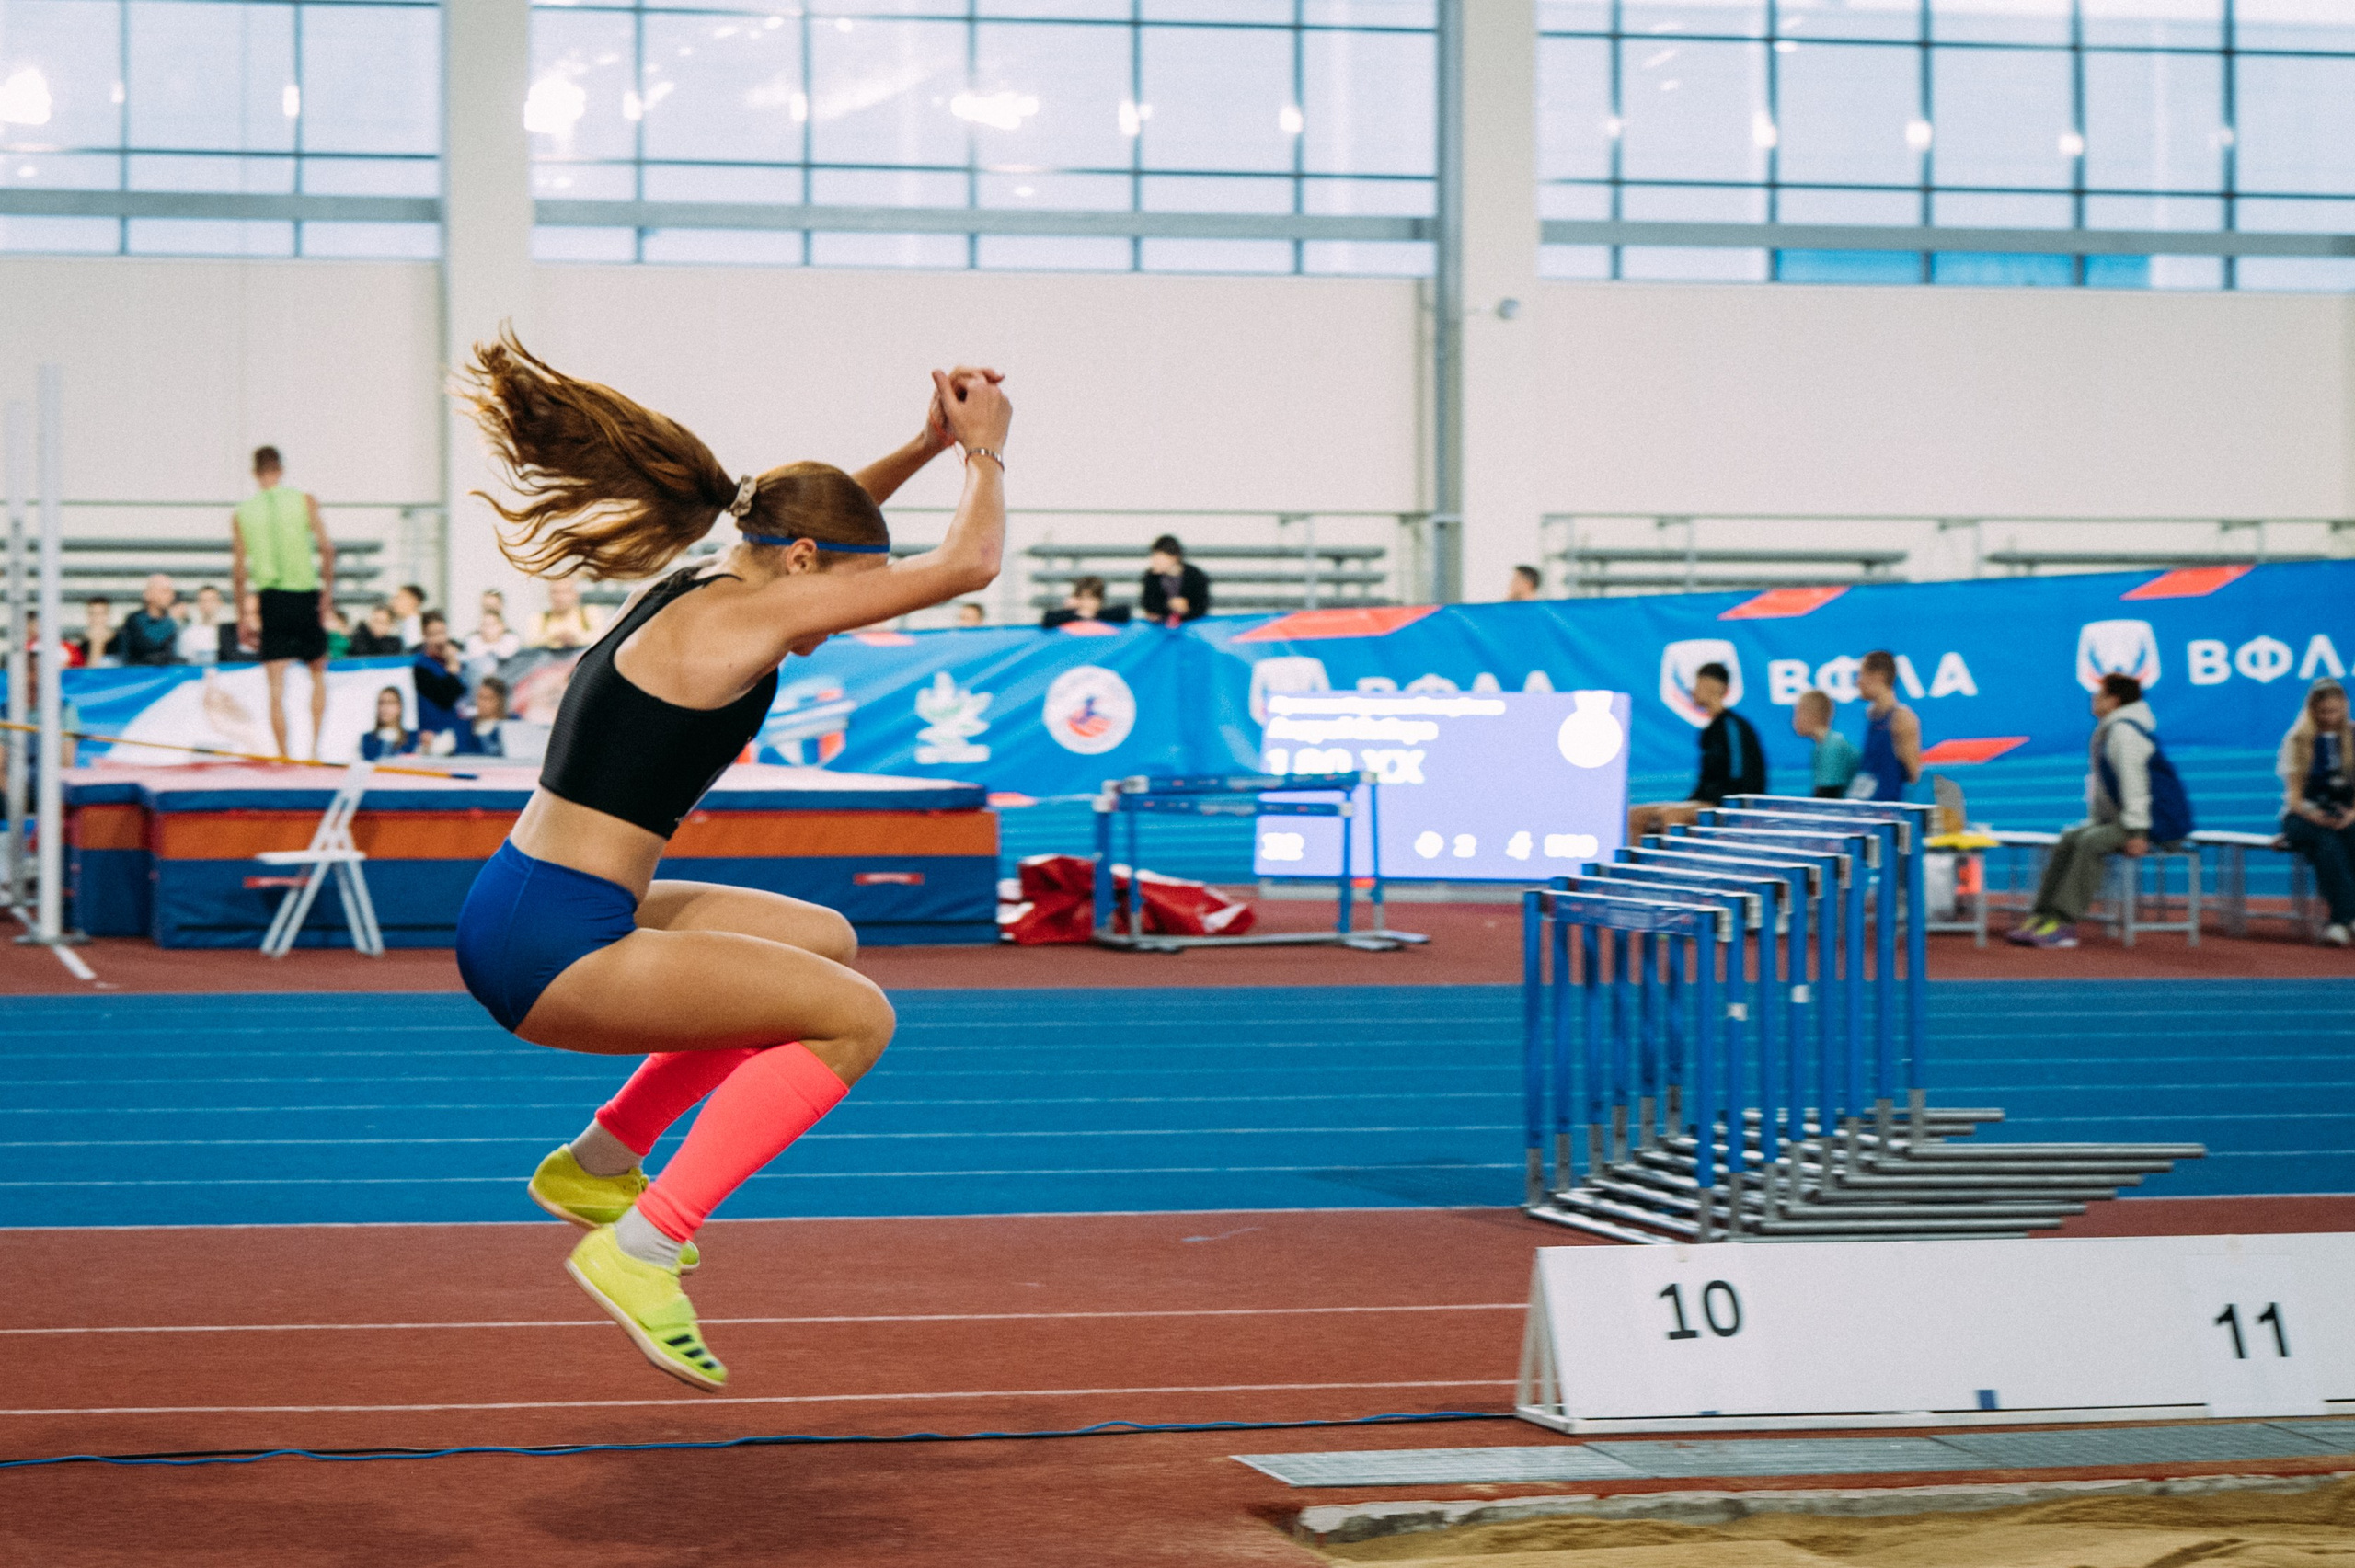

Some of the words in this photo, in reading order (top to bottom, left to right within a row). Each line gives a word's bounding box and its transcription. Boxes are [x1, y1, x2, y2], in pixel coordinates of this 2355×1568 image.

[2187, 634, 2355, 686] ВФЛ
[1657, 1279, 1743, 1341] 10
[2213, 1301, 2292, 1361] 11
